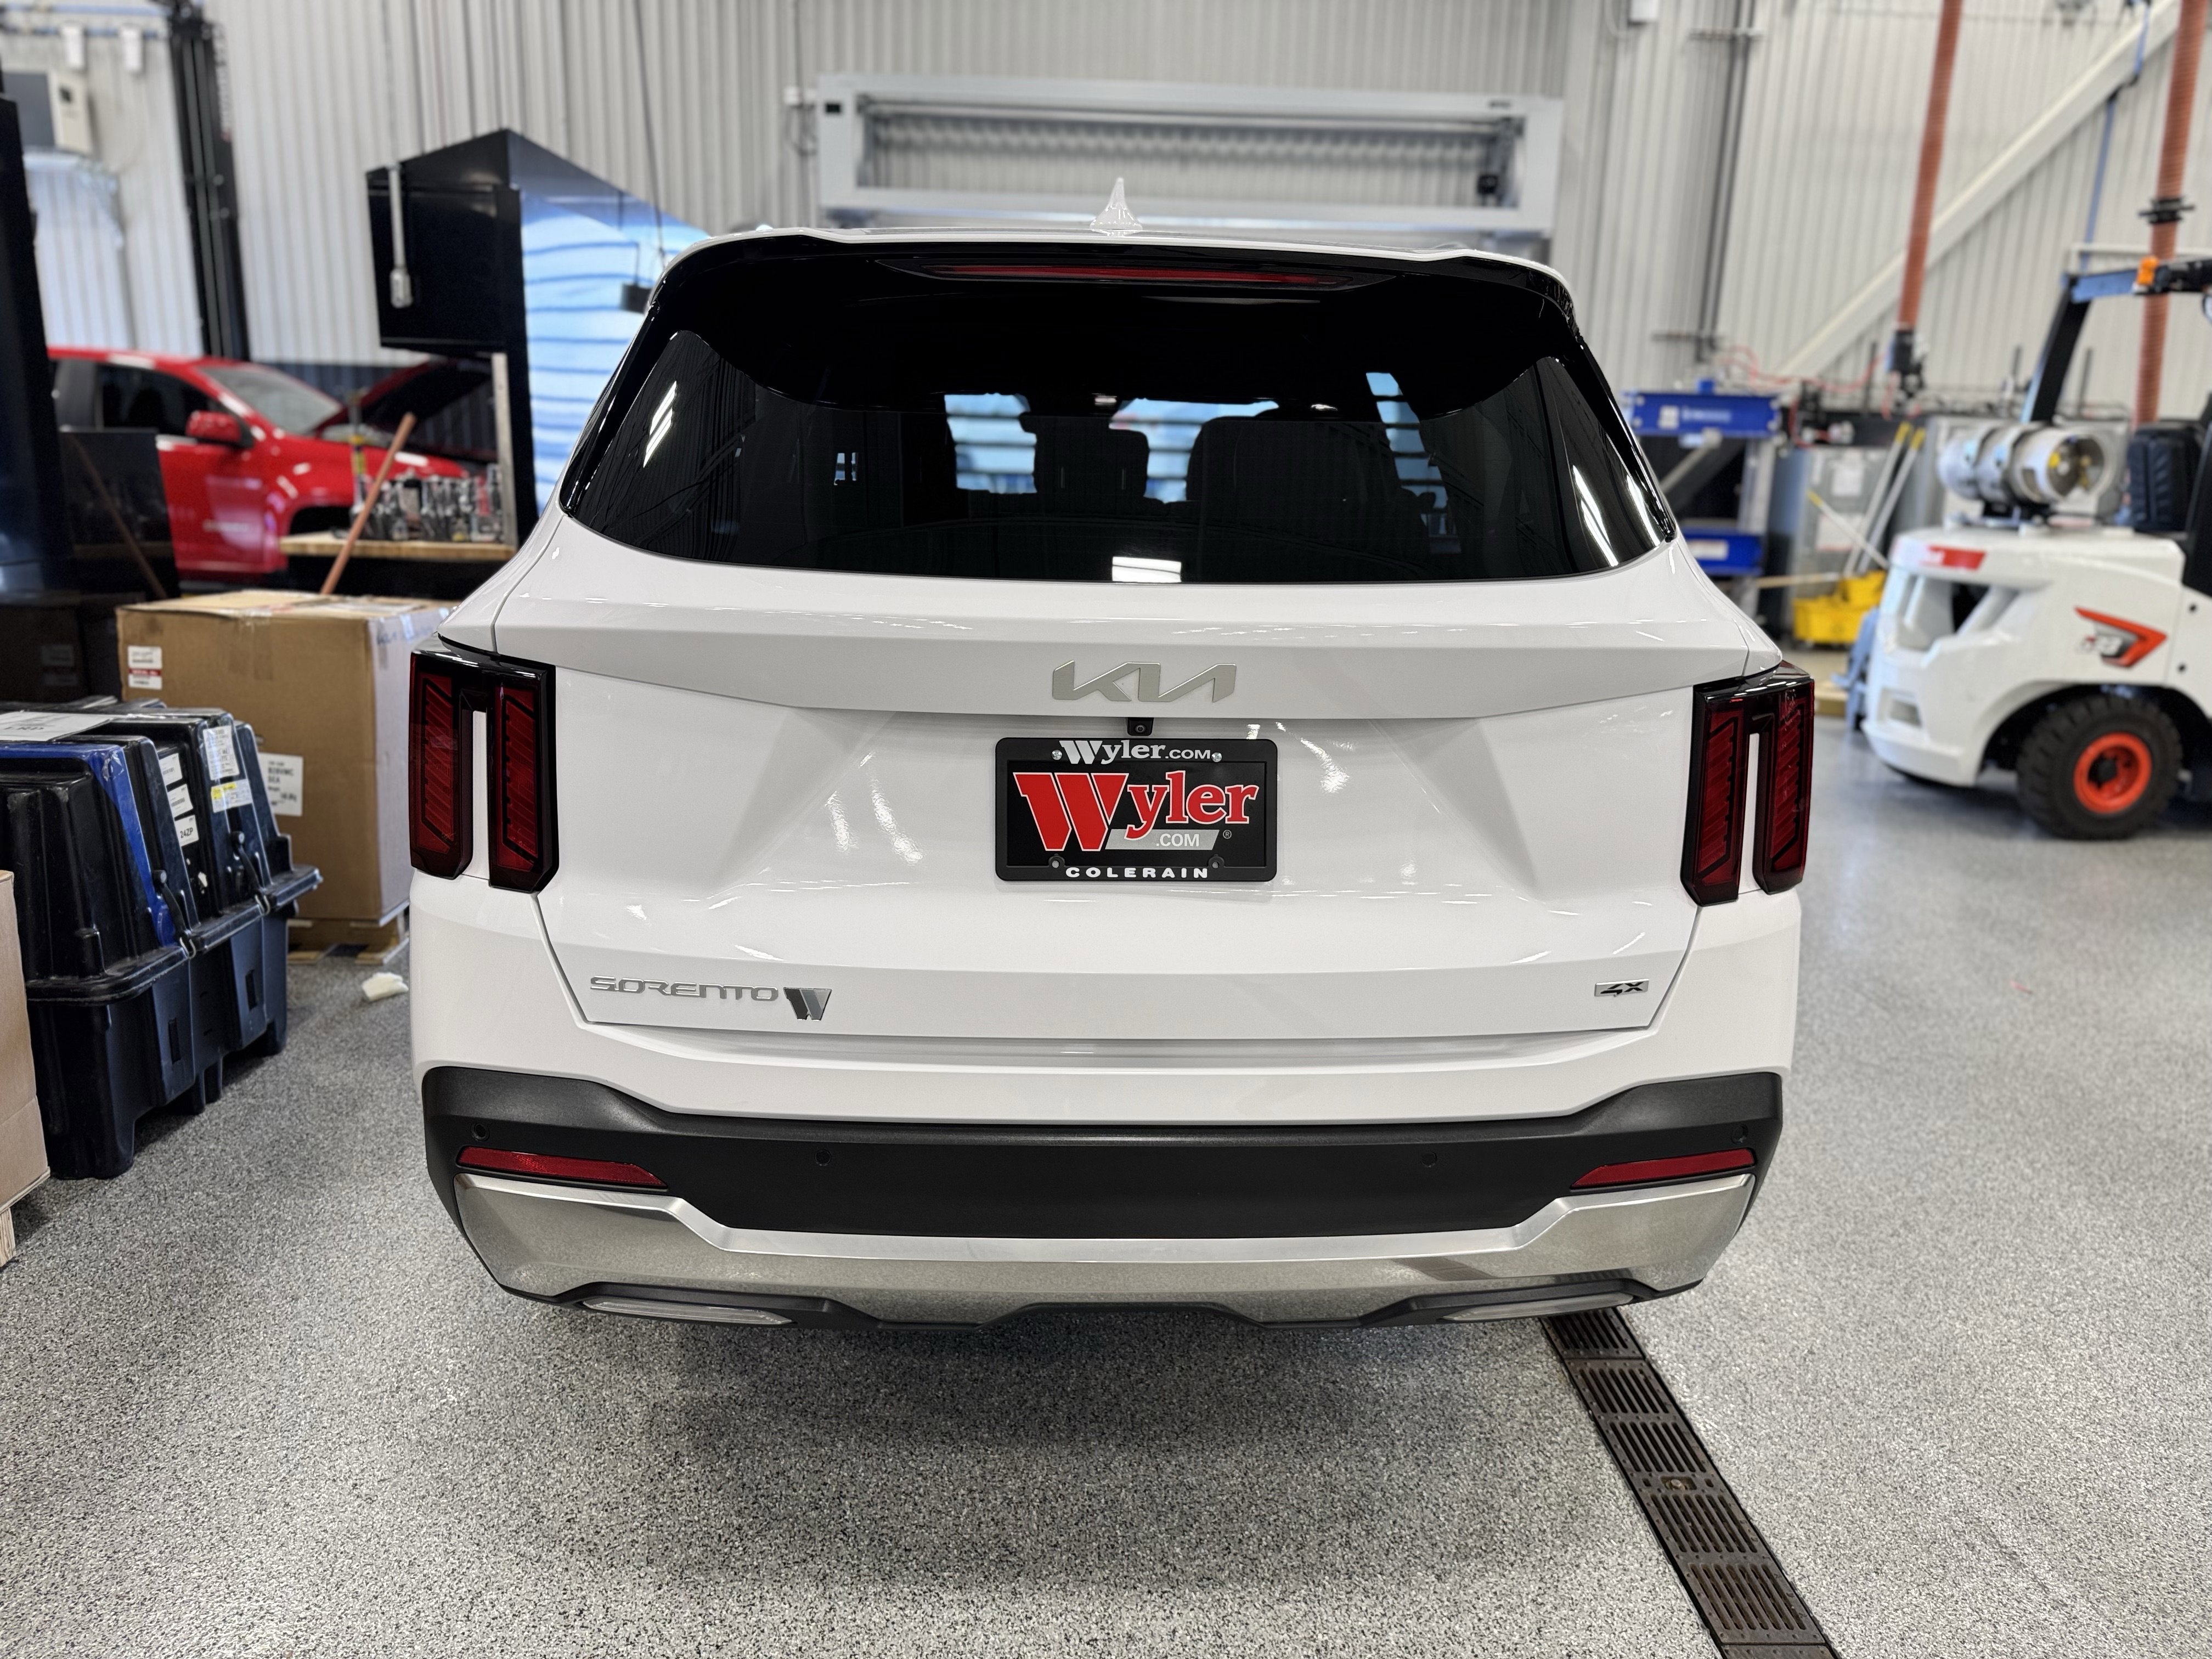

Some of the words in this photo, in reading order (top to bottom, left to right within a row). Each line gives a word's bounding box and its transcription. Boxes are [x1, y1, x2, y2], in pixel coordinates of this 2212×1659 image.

[1052, 660, 1237, 703] KIA
[1013, 770, 1259, 851] Wyler
[180, 827, 194, 839] 24ZP
[1155, 833, 1200, 848] .COM
[1065, 867, 1208, 879] COLERAIN
[590, 975, 779, 1001] SORENTO
